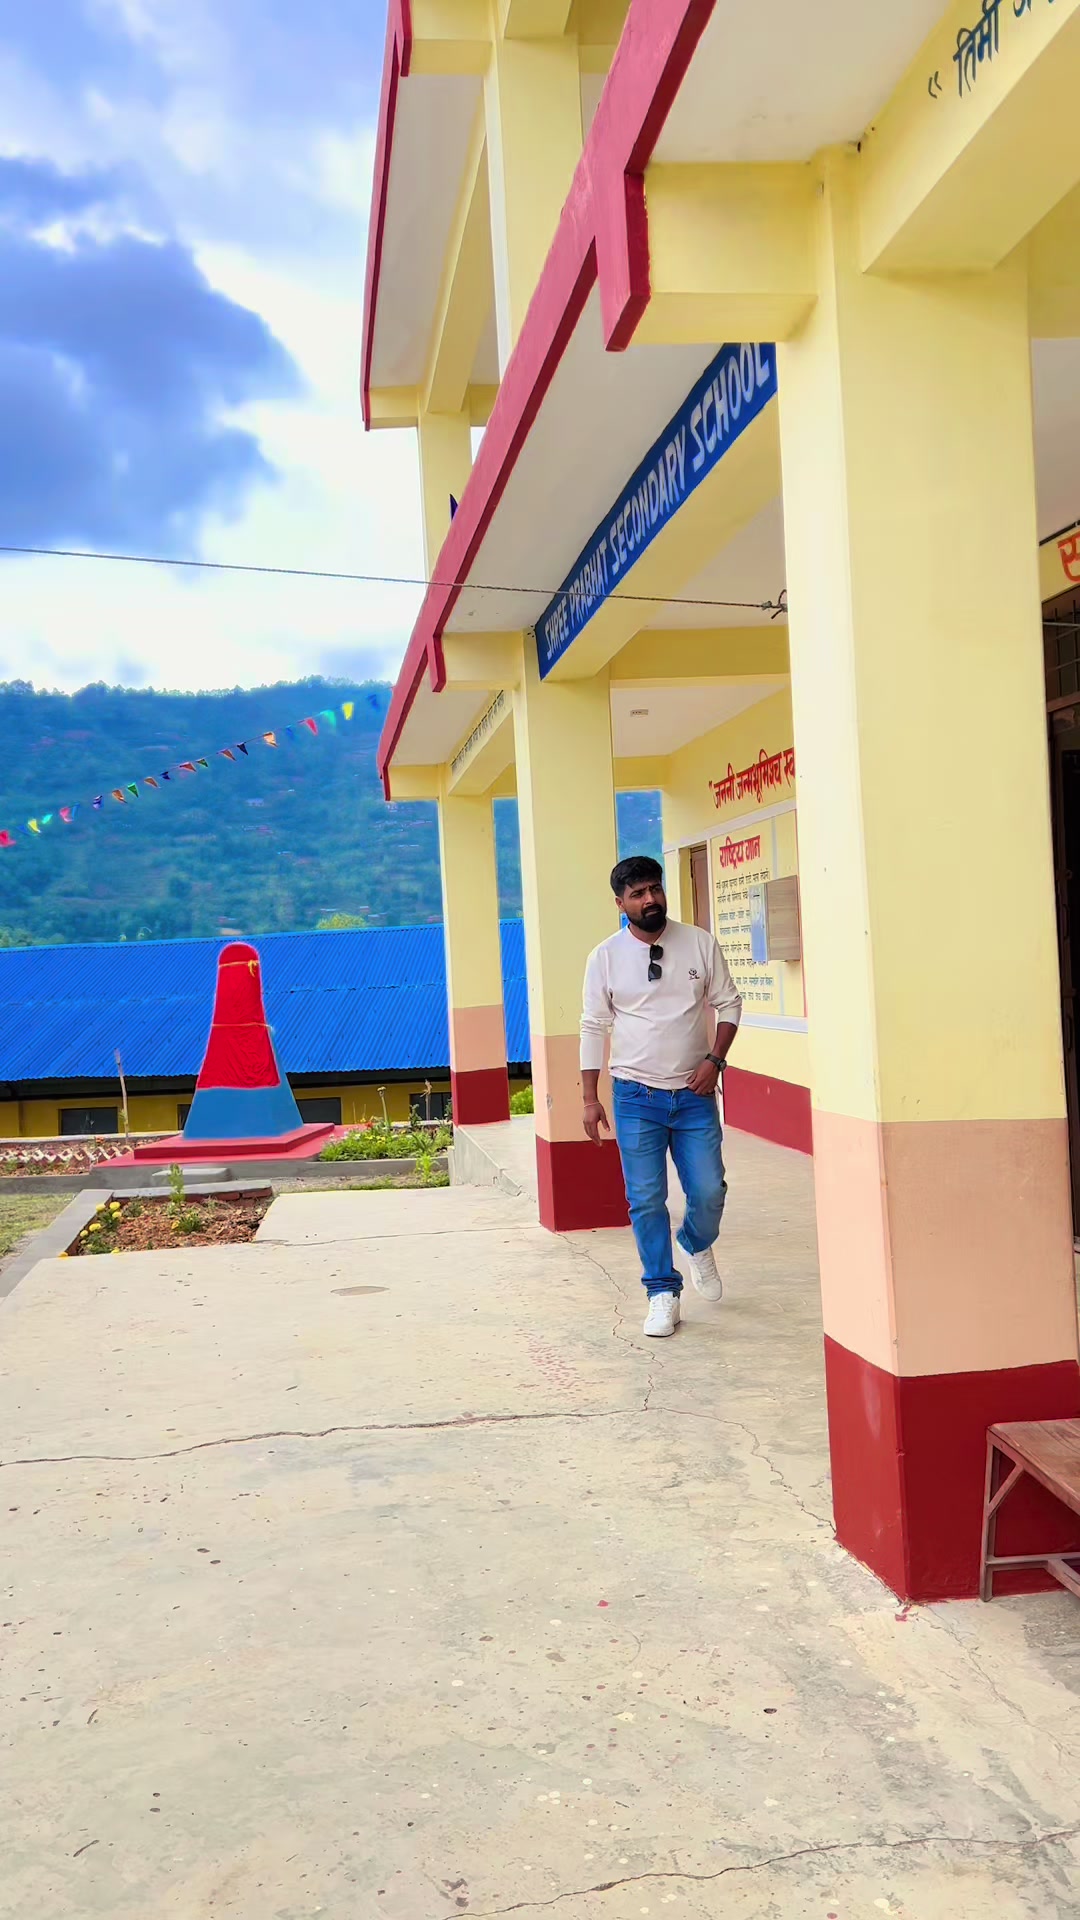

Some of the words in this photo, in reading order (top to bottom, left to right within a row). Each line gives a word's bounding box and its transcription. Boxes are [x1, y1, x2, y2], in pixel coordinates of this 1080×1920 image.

[544, 596, 569, 660] SHREE
[568, 537, 609, 630] PRABHAT
[609, 425, 686, 576] SECONDARY
[690, 342, 770, 473] SCHOOL
